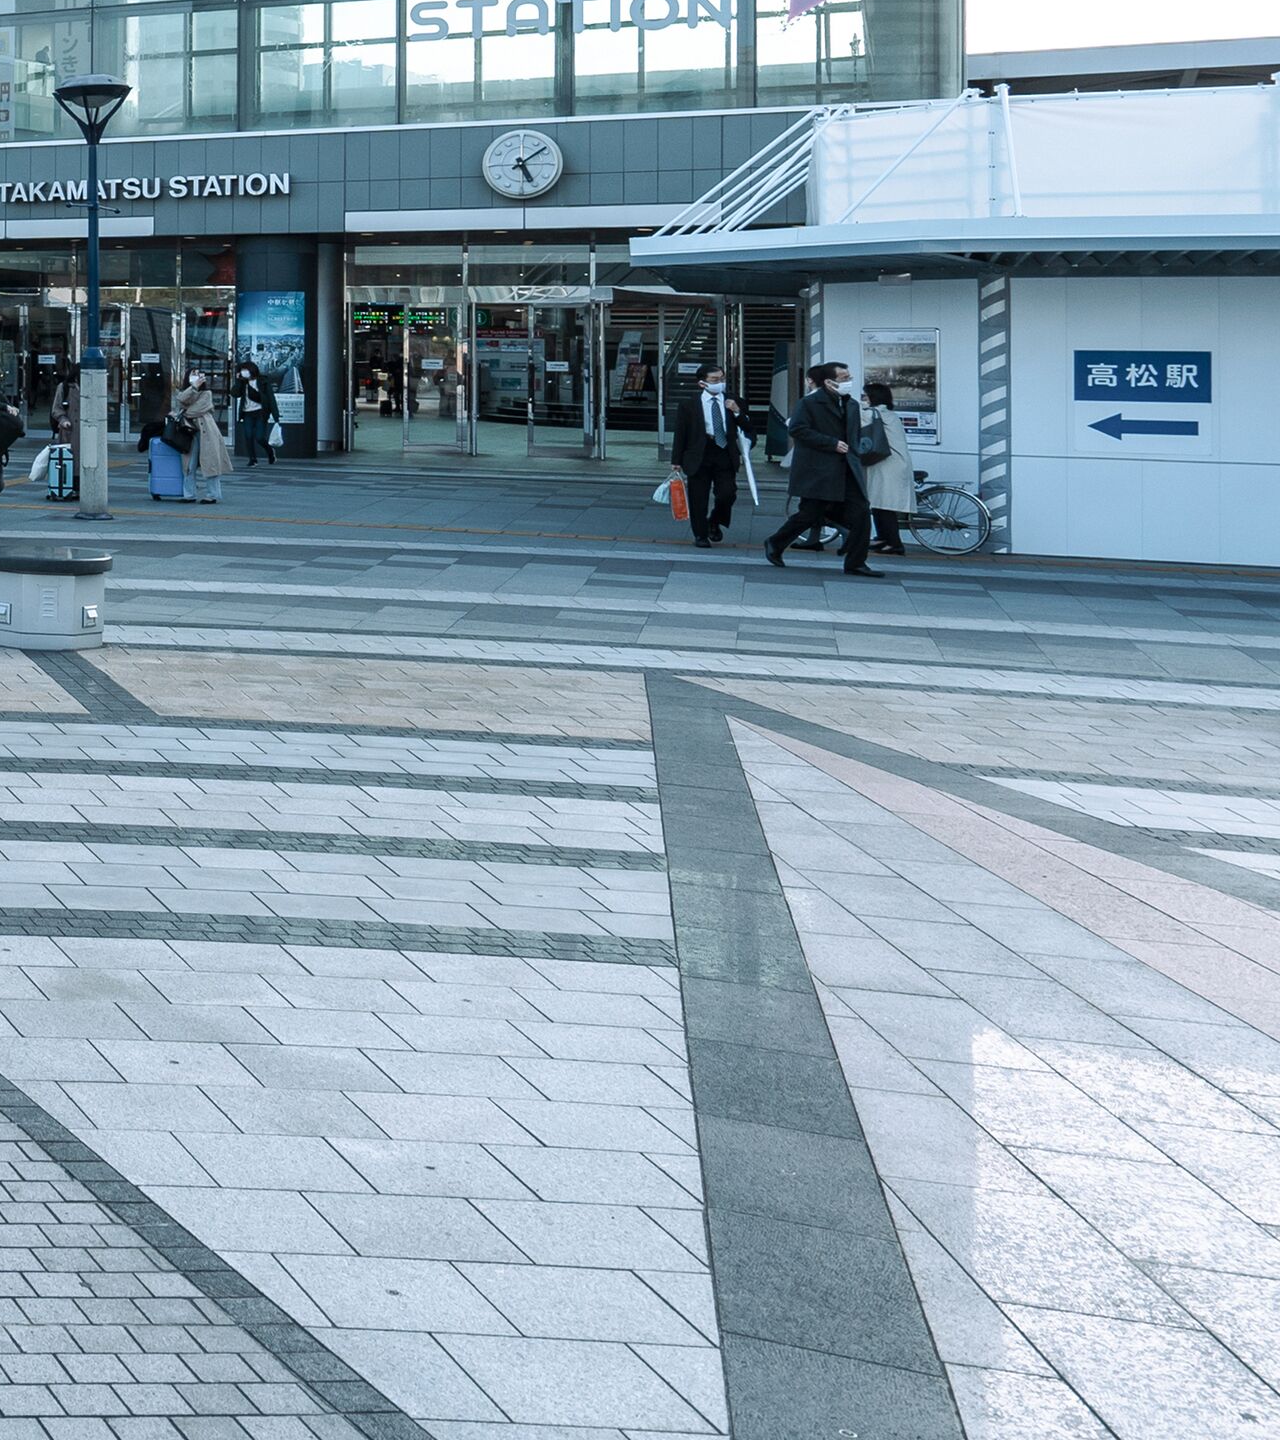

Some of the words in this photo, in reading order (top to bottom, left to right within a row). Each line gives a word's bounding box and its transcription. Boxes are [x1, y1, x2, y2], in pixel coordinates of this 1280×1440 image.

[168, 172, 290, 199] STATION
[1086, 363, 1199, 389] 高松駅
